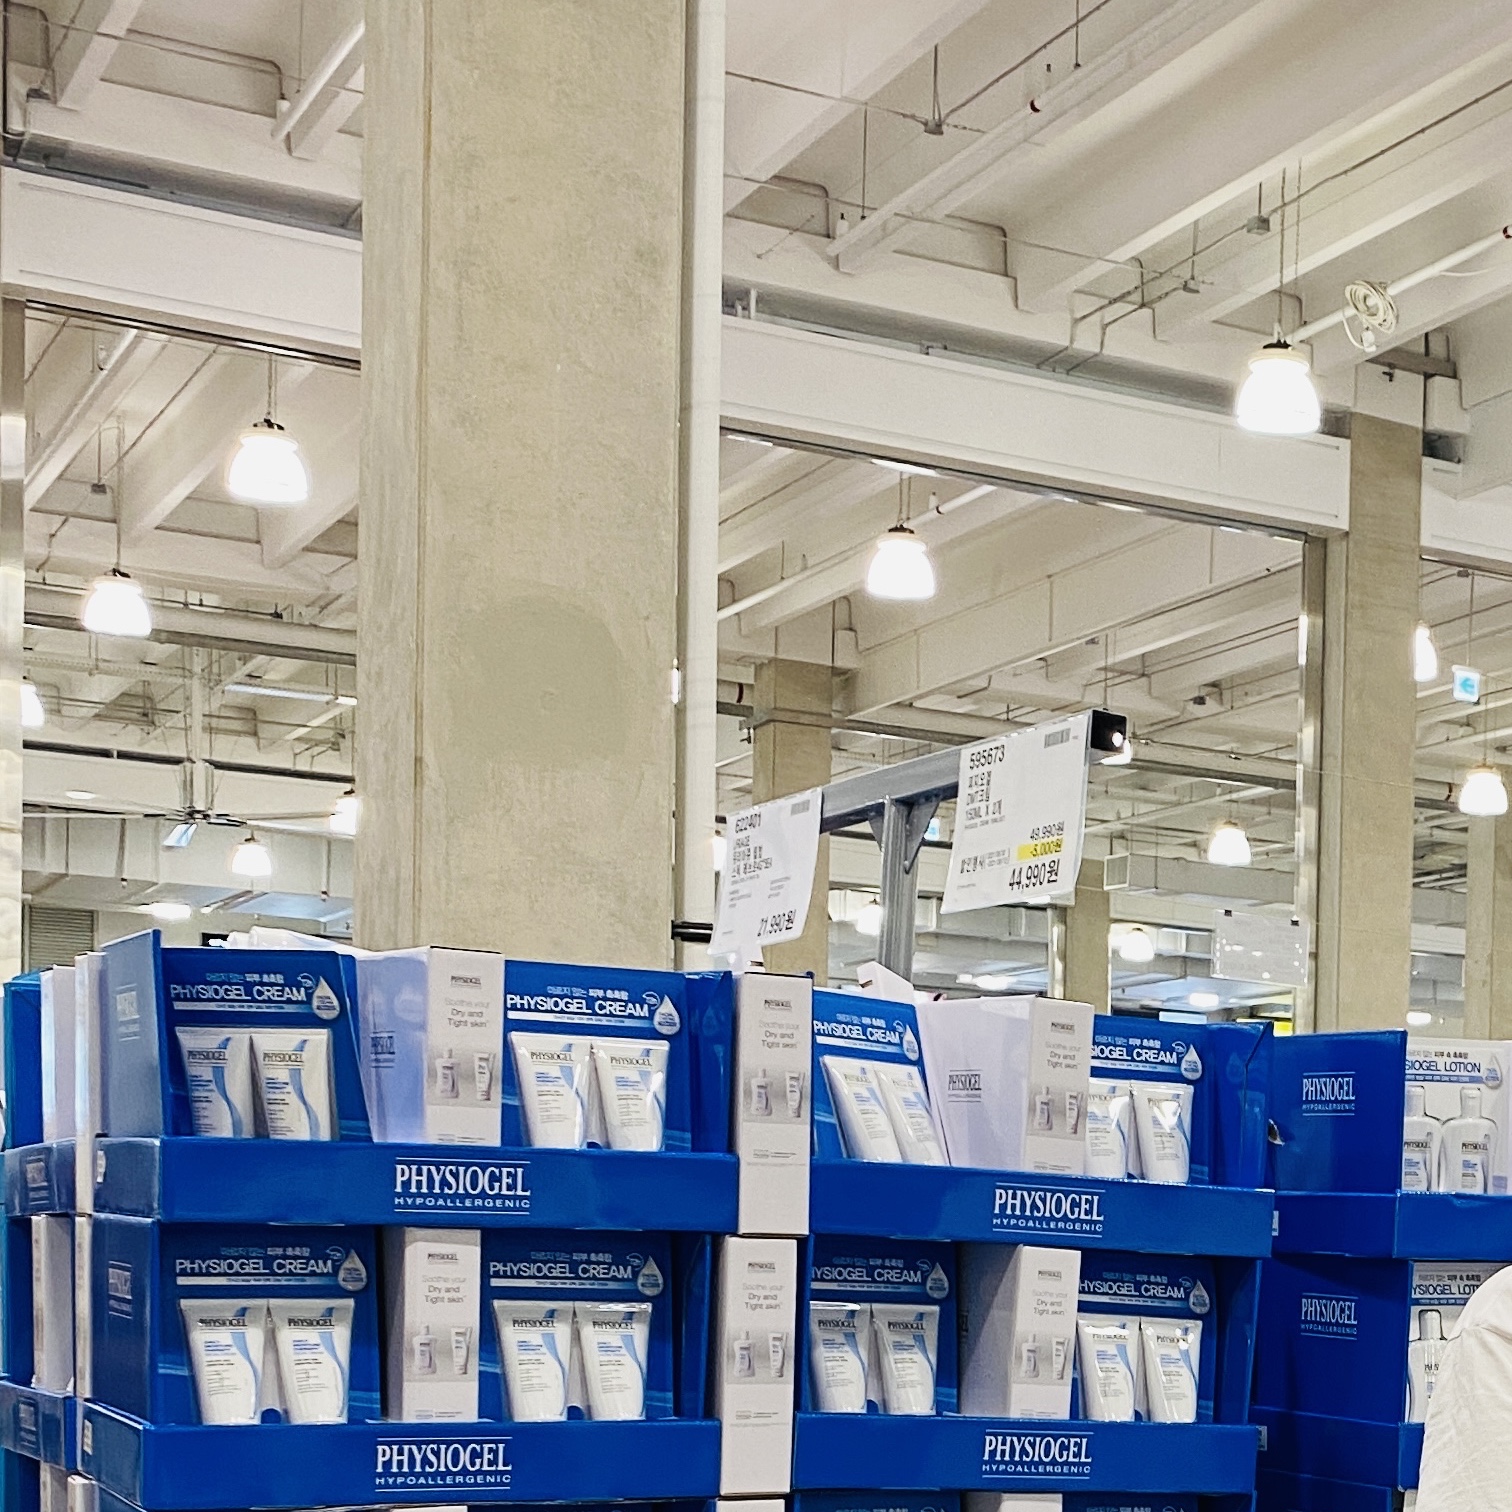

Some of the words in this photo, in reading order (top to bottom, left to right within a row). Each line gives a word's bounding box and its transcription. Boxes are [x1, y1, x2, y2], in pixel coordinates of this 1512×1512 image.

[969, 744, 1006, 770] 595673
[1008, 858, 1061, 893] 44,990원
[171, 984, 251, 1001] PHYSIOGEL
[253, 985, 307, 1002] CREAM
[506, 995, 593, 1013] PHYSIOGEL
[594, 1000, 650, 1018] CREAM
[1405, 1058, 1443, 1073] SIOGEL
[1444, 1061, 1482, 1074] LOTION
[1302, 1077, 1356, 1101] PHYSIOGEL
[394, 1165, 531, 1197] PHYSIOGEL
[394, 1197, 531, 1209] HYPOALLERGENIC
[993, 1188, 1104, 1222] PHYSIOGEL
[992, 1217, 1103, 1232] HYPOALLERGENIC
[423, 1294, 445, 1307] Tight
[427, 1284, 444, 1297] Dry
[446, 1284, 462, 1295] and
[1301, 1297, 1358, 1325] PHYSIOGEL
[376, 1442, 512, 1473] PHYSIOGEL
[982, 1435, 1093, 1463] PHYSIOGEL
[375, 1474, 512, 1485] HYPOALLERGENIC
[981, 1463, 1092, 1474] HYPOALLERGENIC
